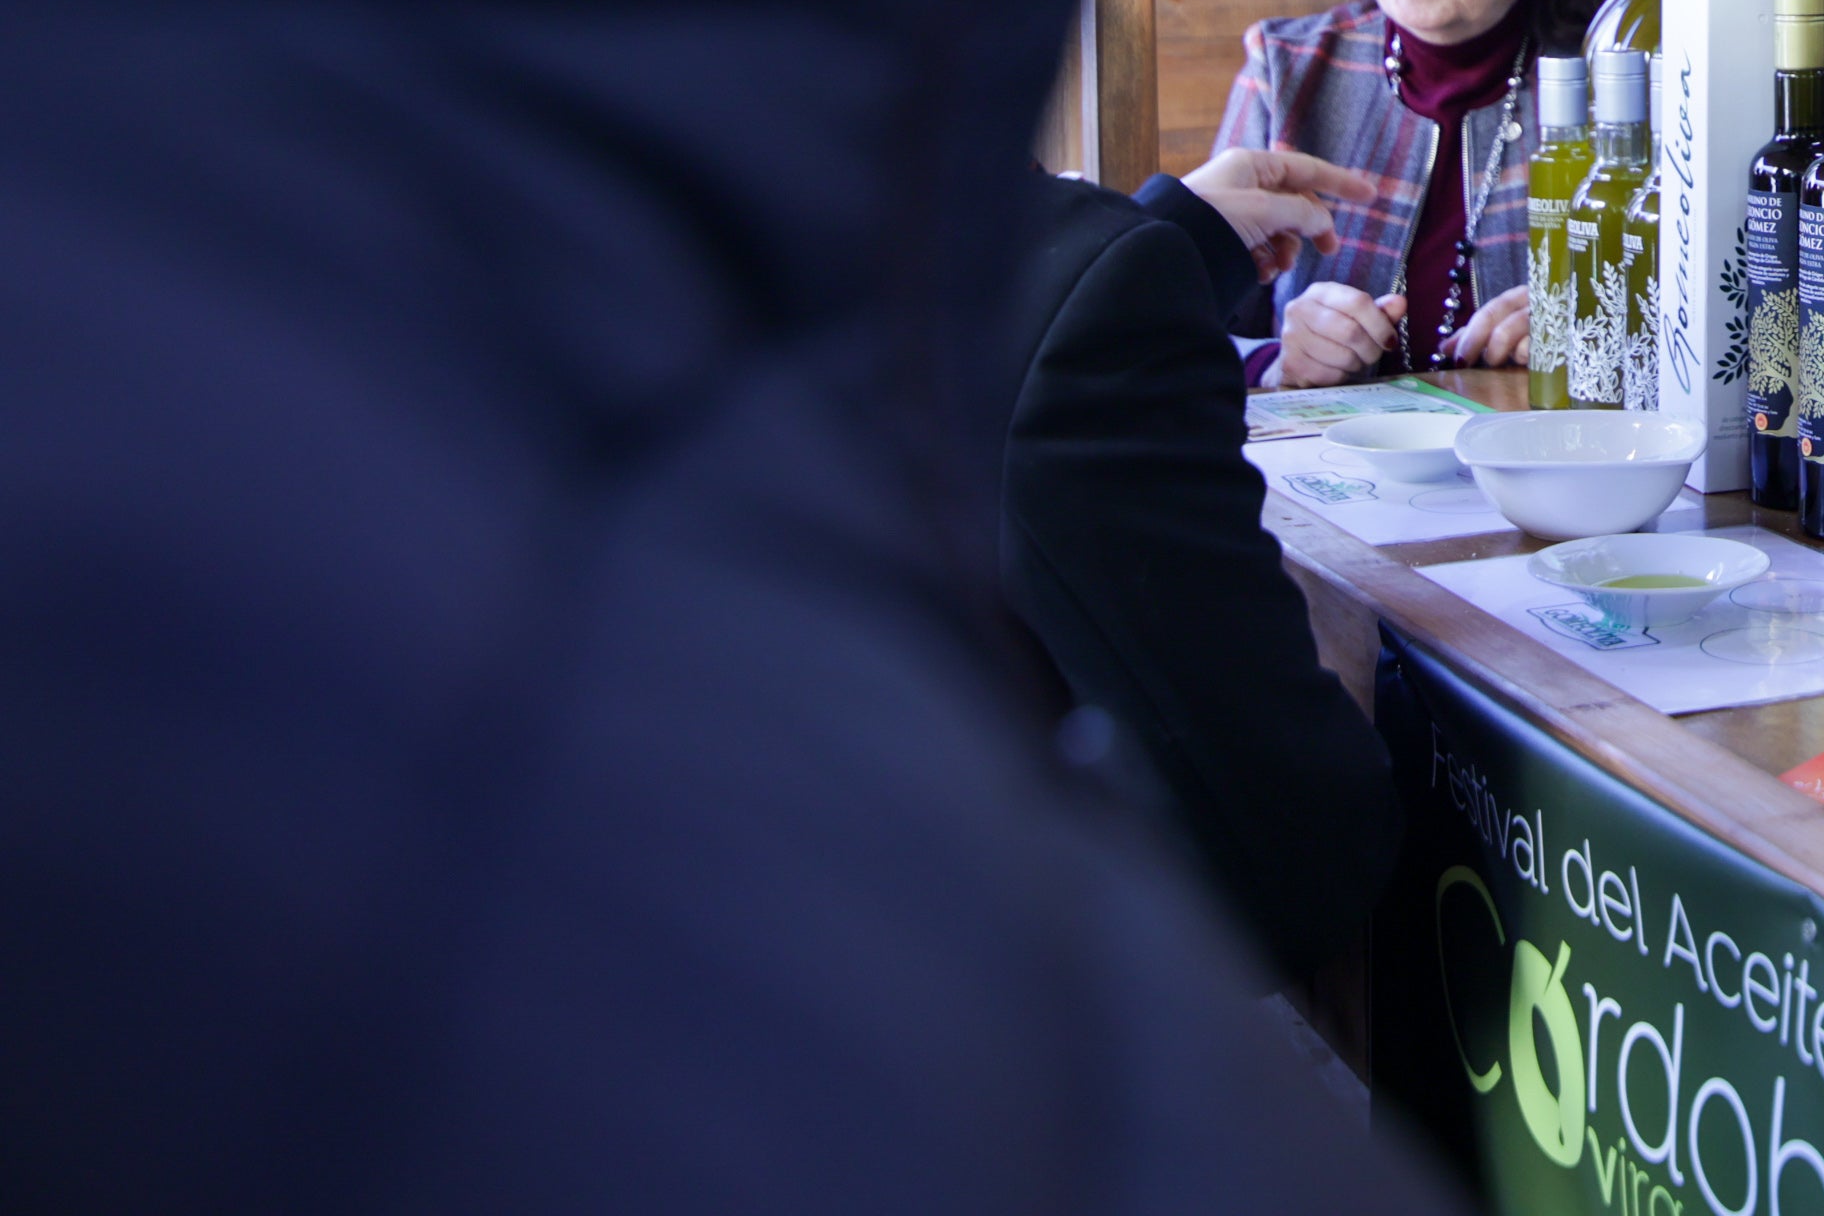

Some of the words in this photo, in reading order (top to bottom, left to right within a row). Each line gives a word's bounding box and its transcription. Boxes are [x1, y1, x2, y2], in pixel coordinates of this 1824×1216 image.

[1664, 48, 1701, 396] Gomeoliva
[1769, 197, 1783, 207] DE
[1431, 721, 1550, 895] Festival
[1561, 838, 1649, 957] del
